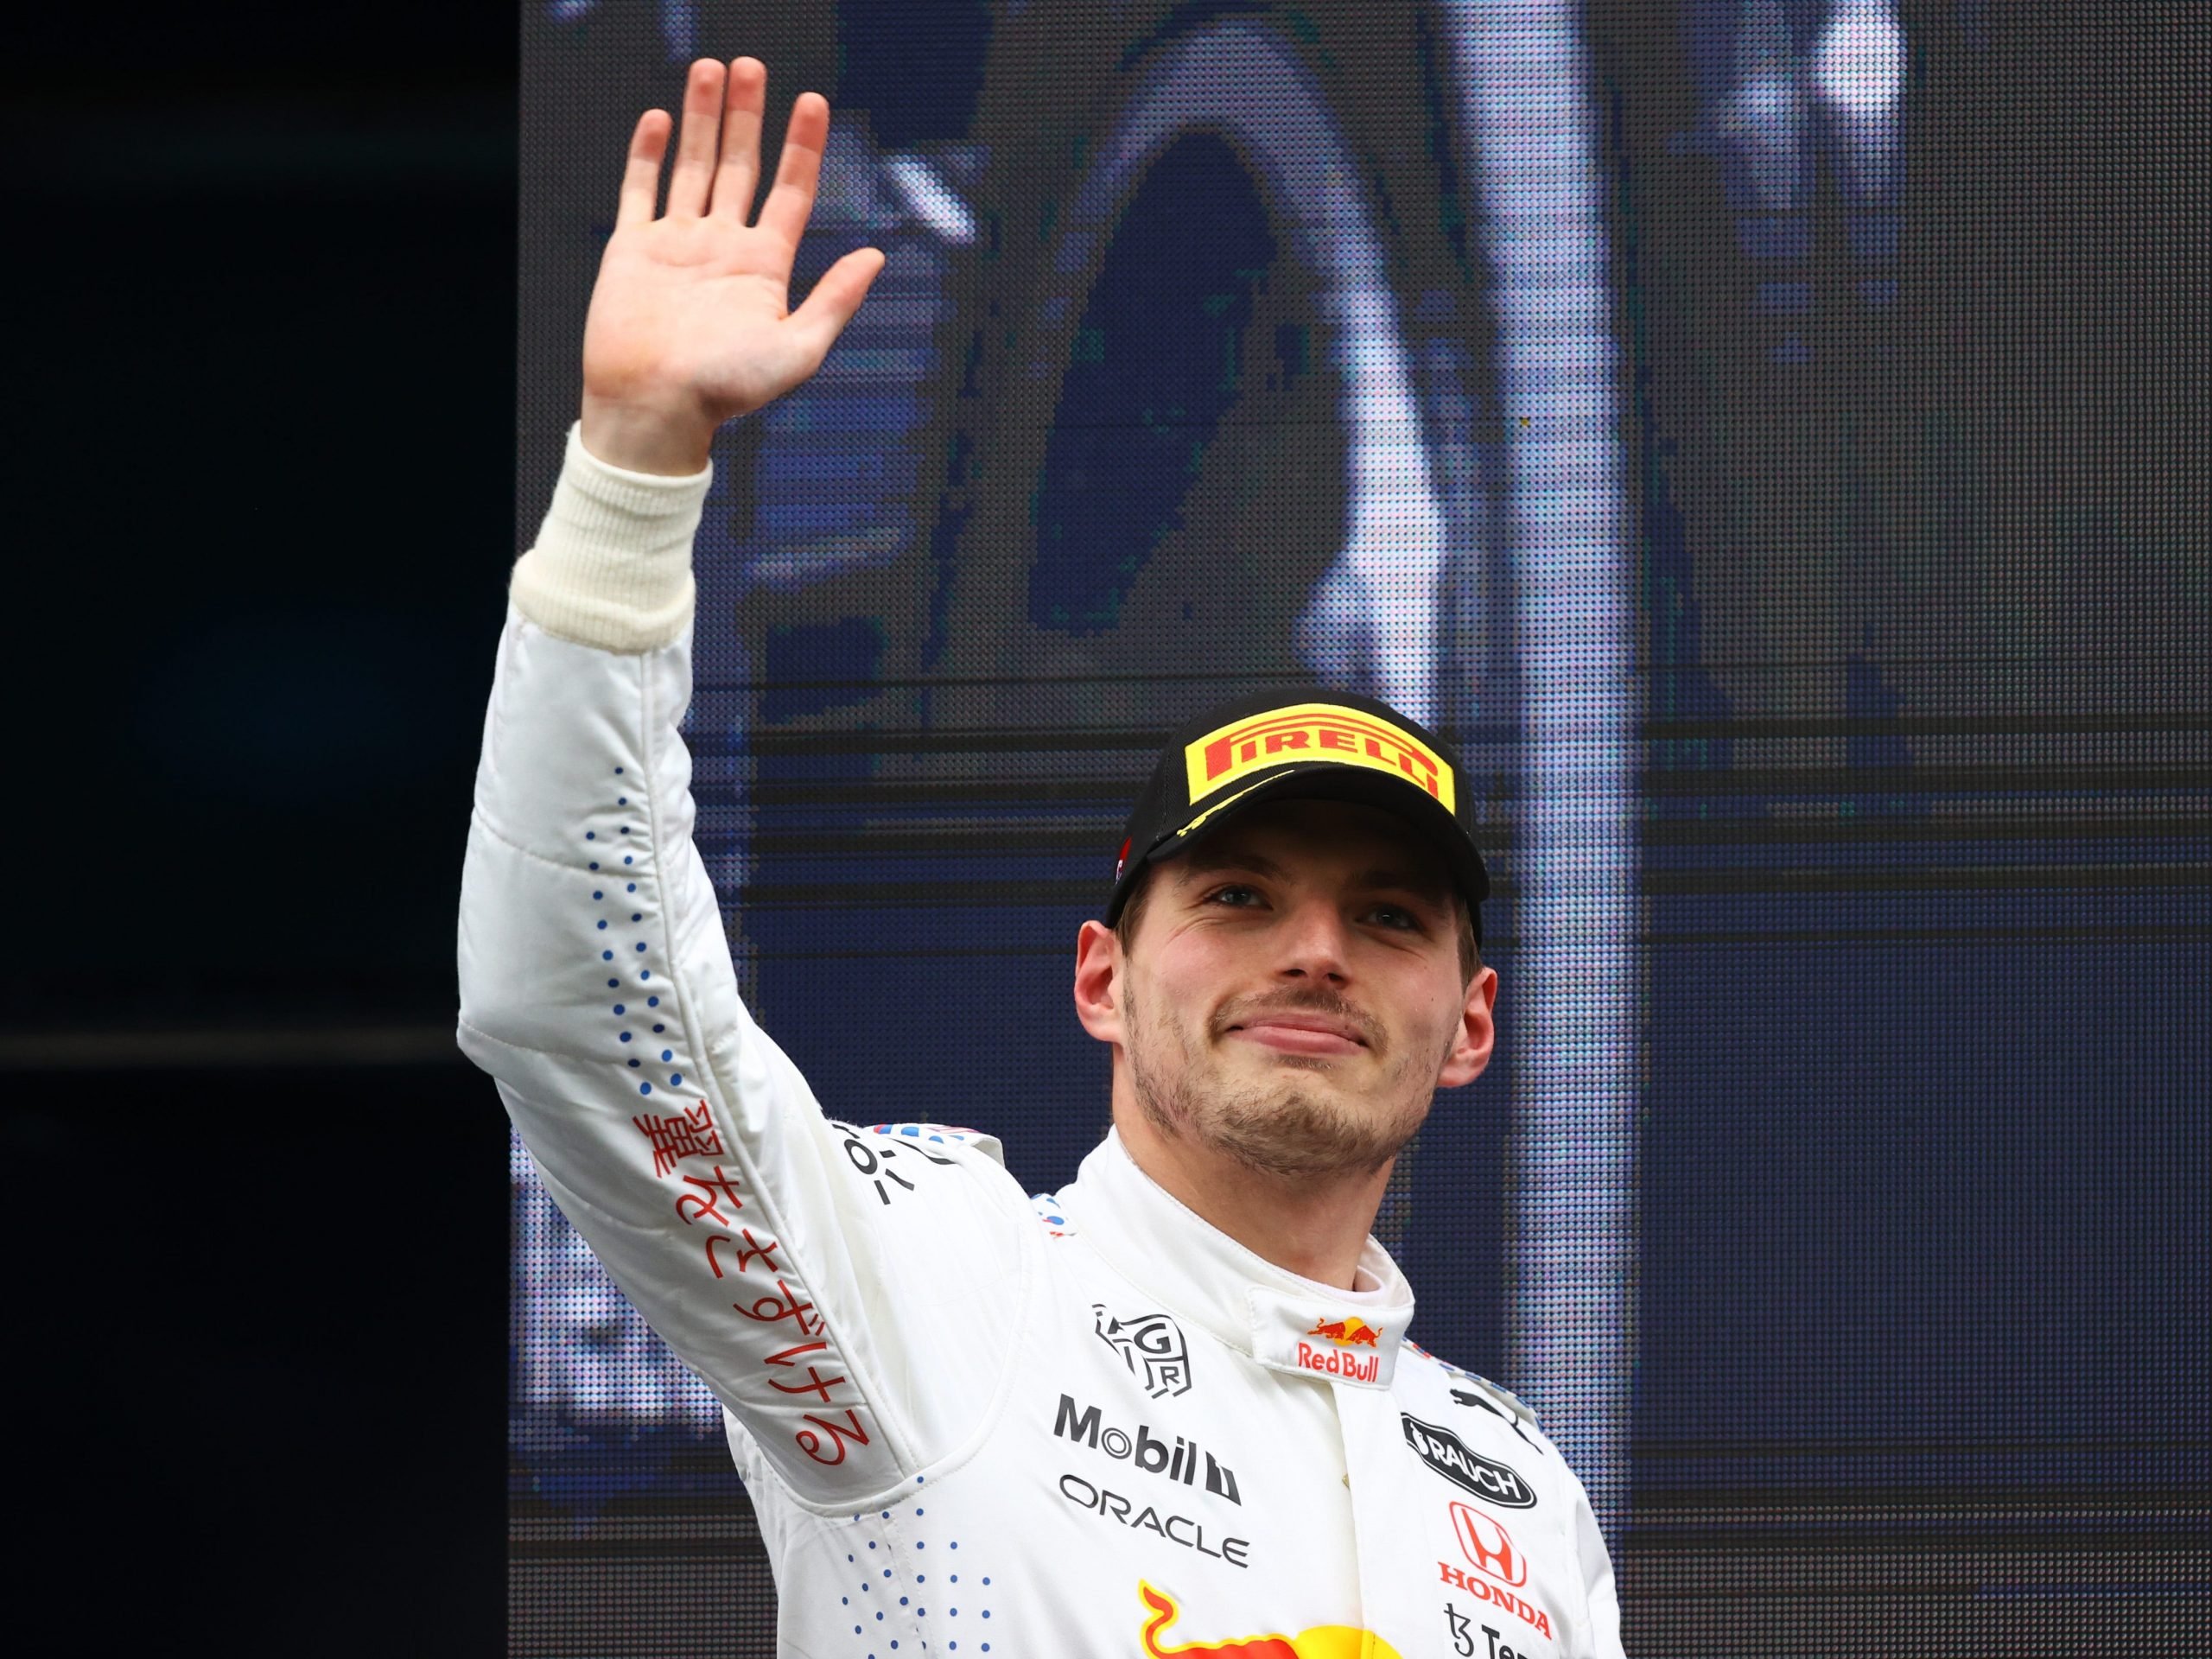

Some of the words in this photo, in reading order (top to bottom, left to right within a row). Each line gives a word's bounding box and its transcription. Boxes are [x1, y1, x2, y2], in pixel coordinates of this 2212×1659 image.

[1205, 713, 1439, 799] PIRELLI
[632, 1099, 871, 1467] 翼をさずける
[1298, 1342, 1339, 1374] Red
[1342, 1352, 1379, 1382] Bull
[1053, 1393, 1197, 1486] Mobil
[1426, 1434, 1522, 1500] RAUCH
[1059, 1474, 1250, 1569] ORACLE
[1438, 1561, 1552, 1640] HONDA
